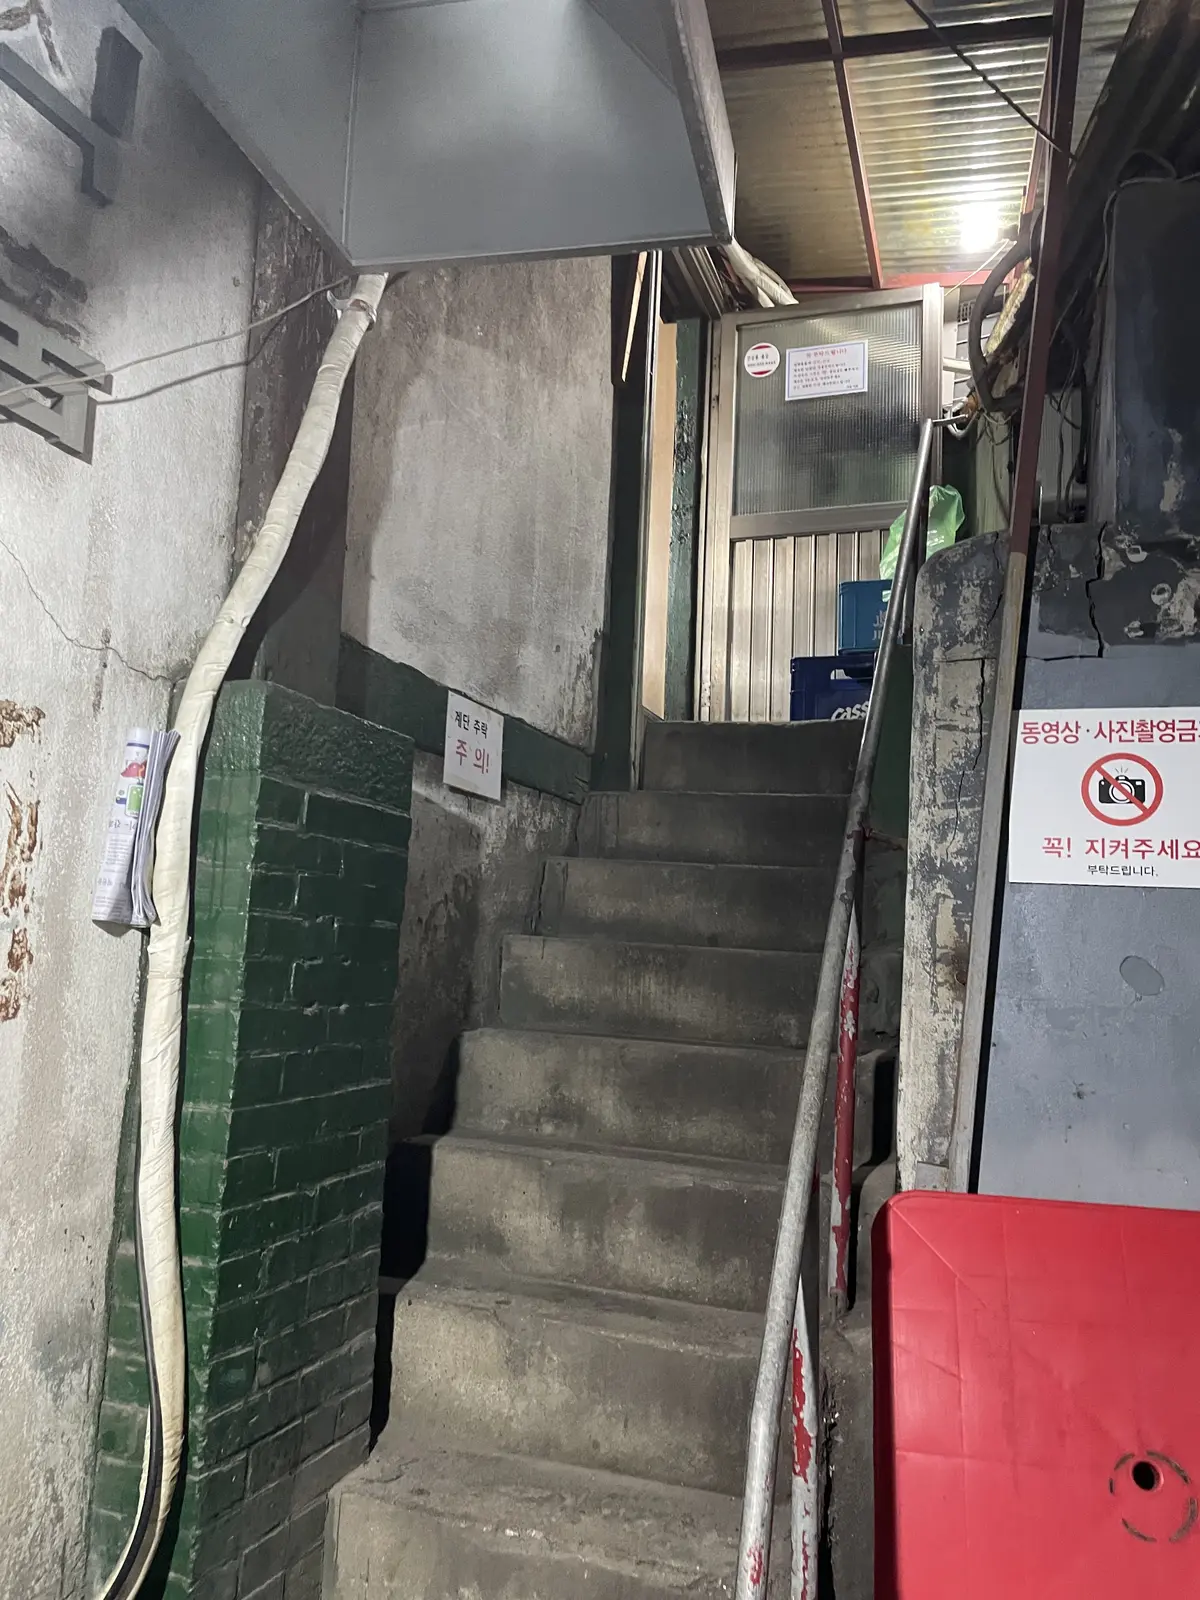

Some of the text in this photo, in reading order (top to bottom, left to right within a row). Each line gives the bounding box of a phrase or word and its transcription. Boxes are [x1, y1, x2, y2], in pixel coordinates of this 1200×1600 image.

[454, 710, 488, 739] 계단 추락
[1042, 837, 1200, 861] 꼭! 지켜주세요
[1087, 864, 1158, 877] 부탁드립니다.
